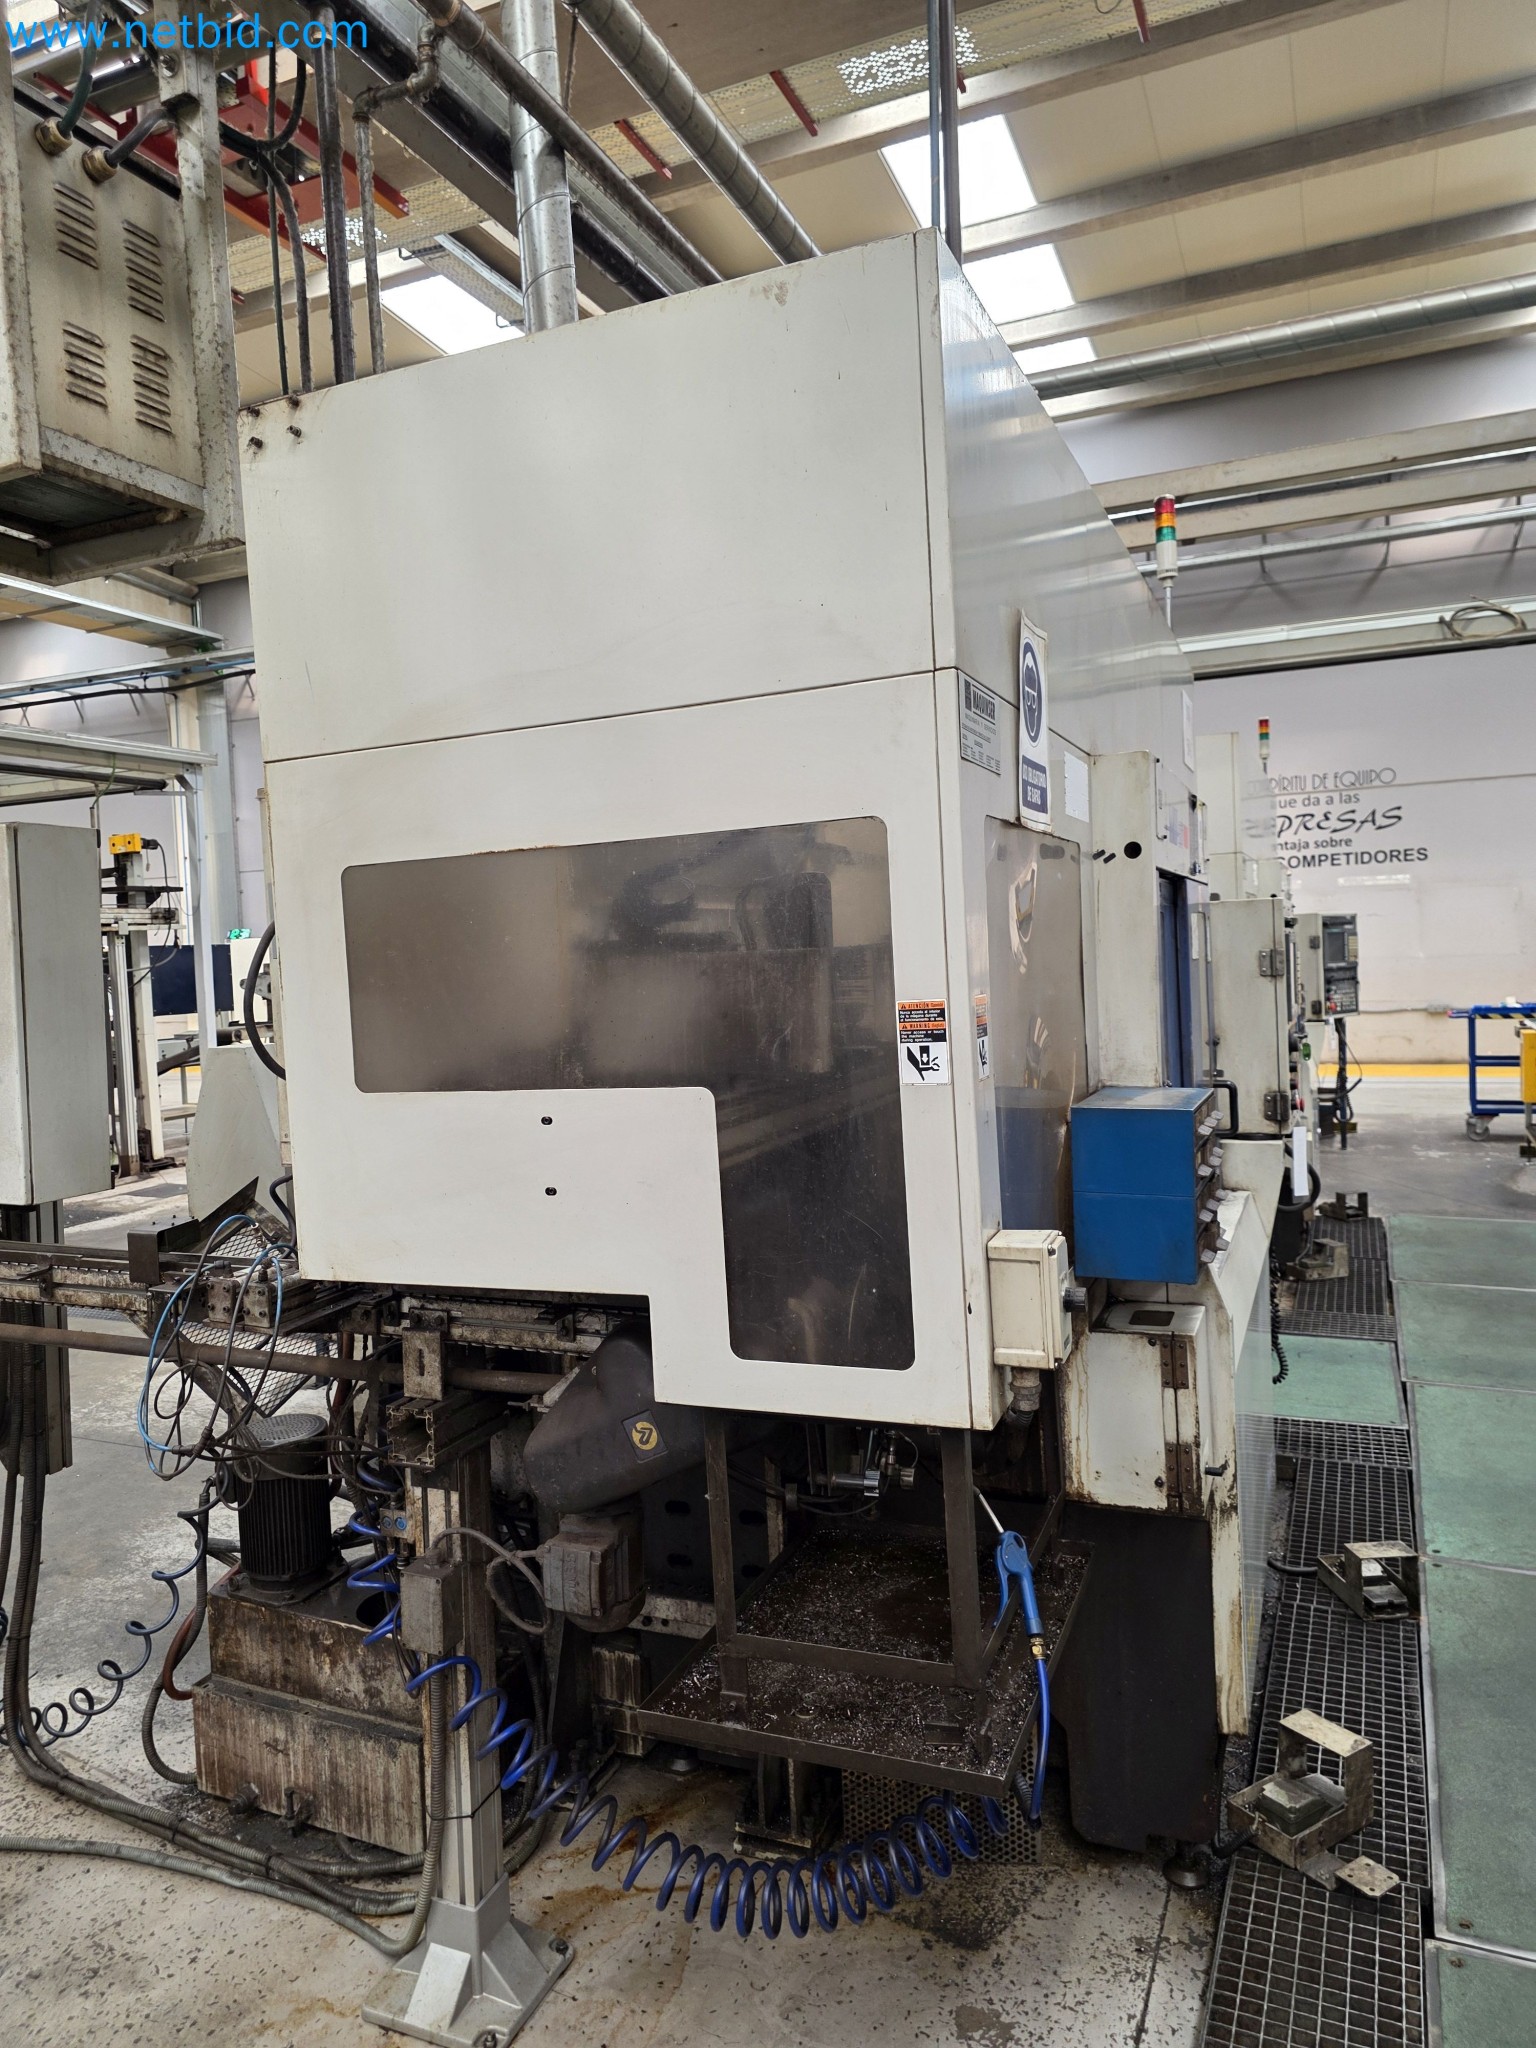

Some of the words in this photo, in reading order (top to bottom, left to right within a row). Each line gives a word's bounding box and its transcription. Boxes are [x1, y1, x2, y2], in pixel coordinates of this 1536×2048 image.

[1311, 771, 1329, 790] DE
[1334, 767, 1397, 789] EQUIPO
[1278, 798, 1297, 809] ue
[1302, 795, 1320, 807] da
[1325, 795, 1334, 805] a
[1339, 792, 1361, 804] las
[1276, 806, 1403, 838] PRESAS
[1276, 838, 1310, 852] ntaja
[1314, 836, 1353, 850] sobre
